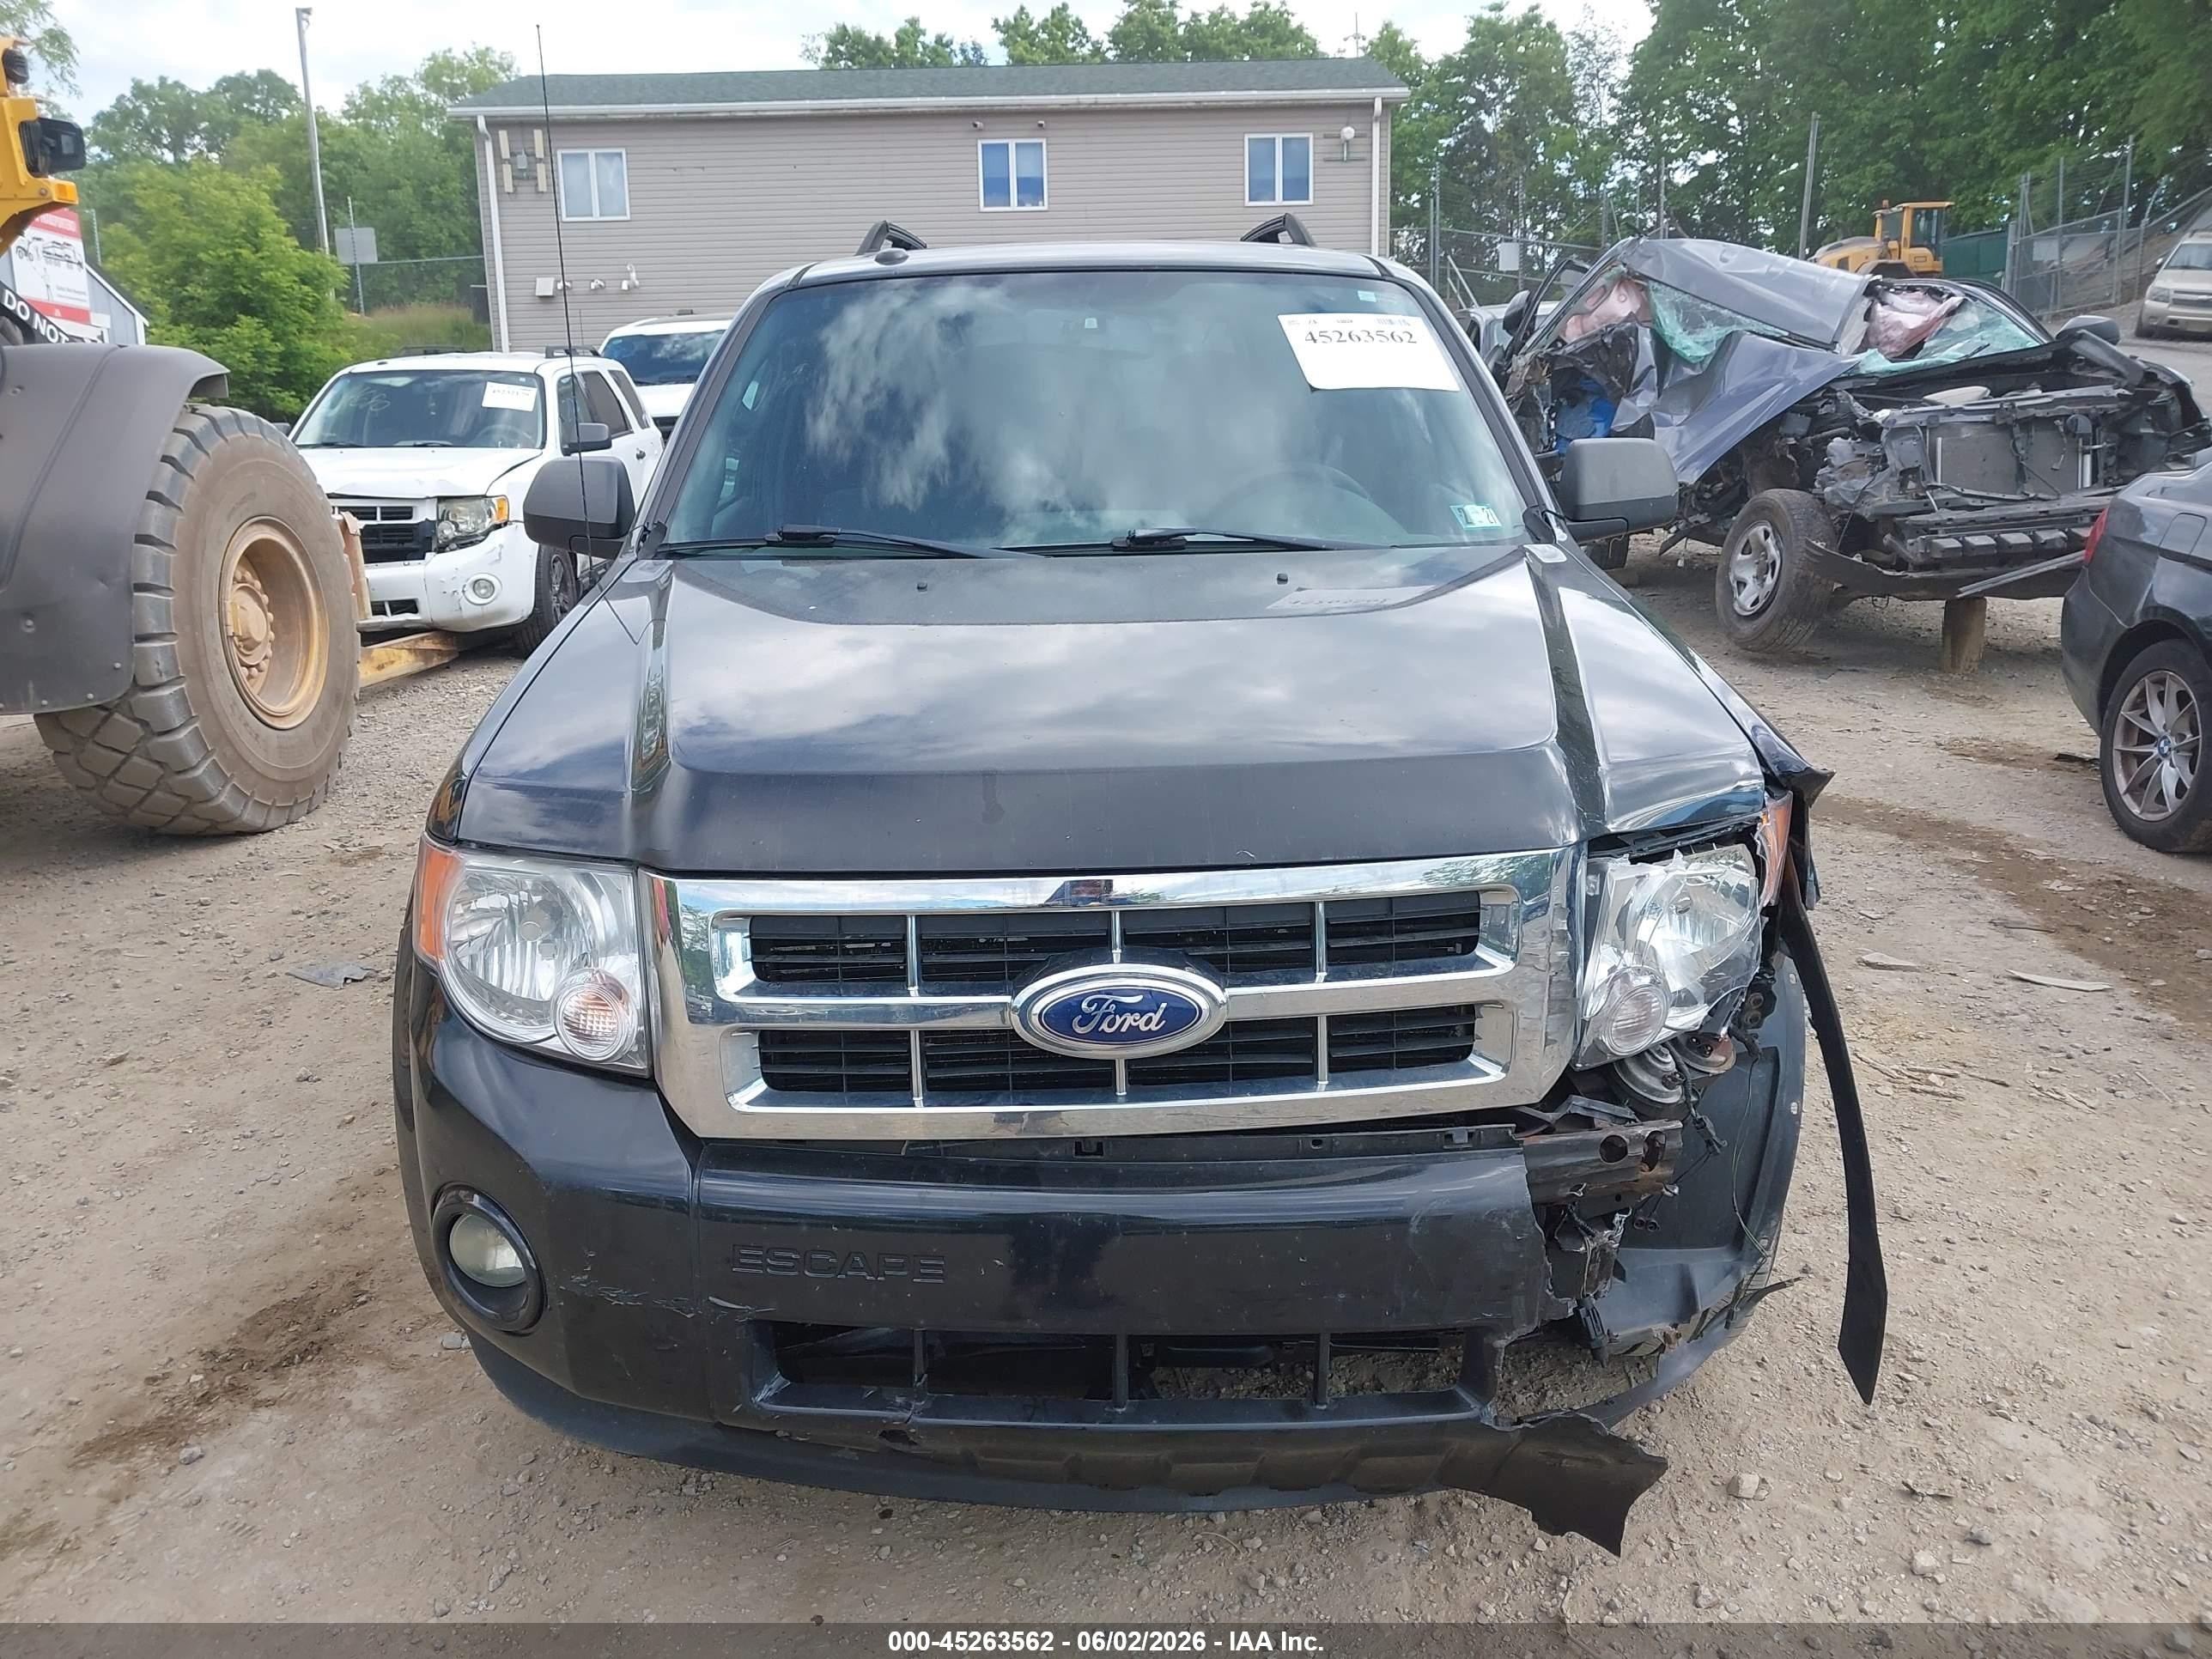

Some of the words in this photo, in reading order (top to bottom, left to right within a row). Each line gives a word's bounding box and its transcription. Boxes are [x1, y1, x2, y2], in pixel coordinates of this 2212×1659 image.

[3, 289, 31, 321] DO
[33, 312, 70, 343] NOT
[1304, 330, 1418, 343] 45263562
[1072, 994, 1168, 1034] Ford
[732, 1243, 946, 1284] ESCAPE
